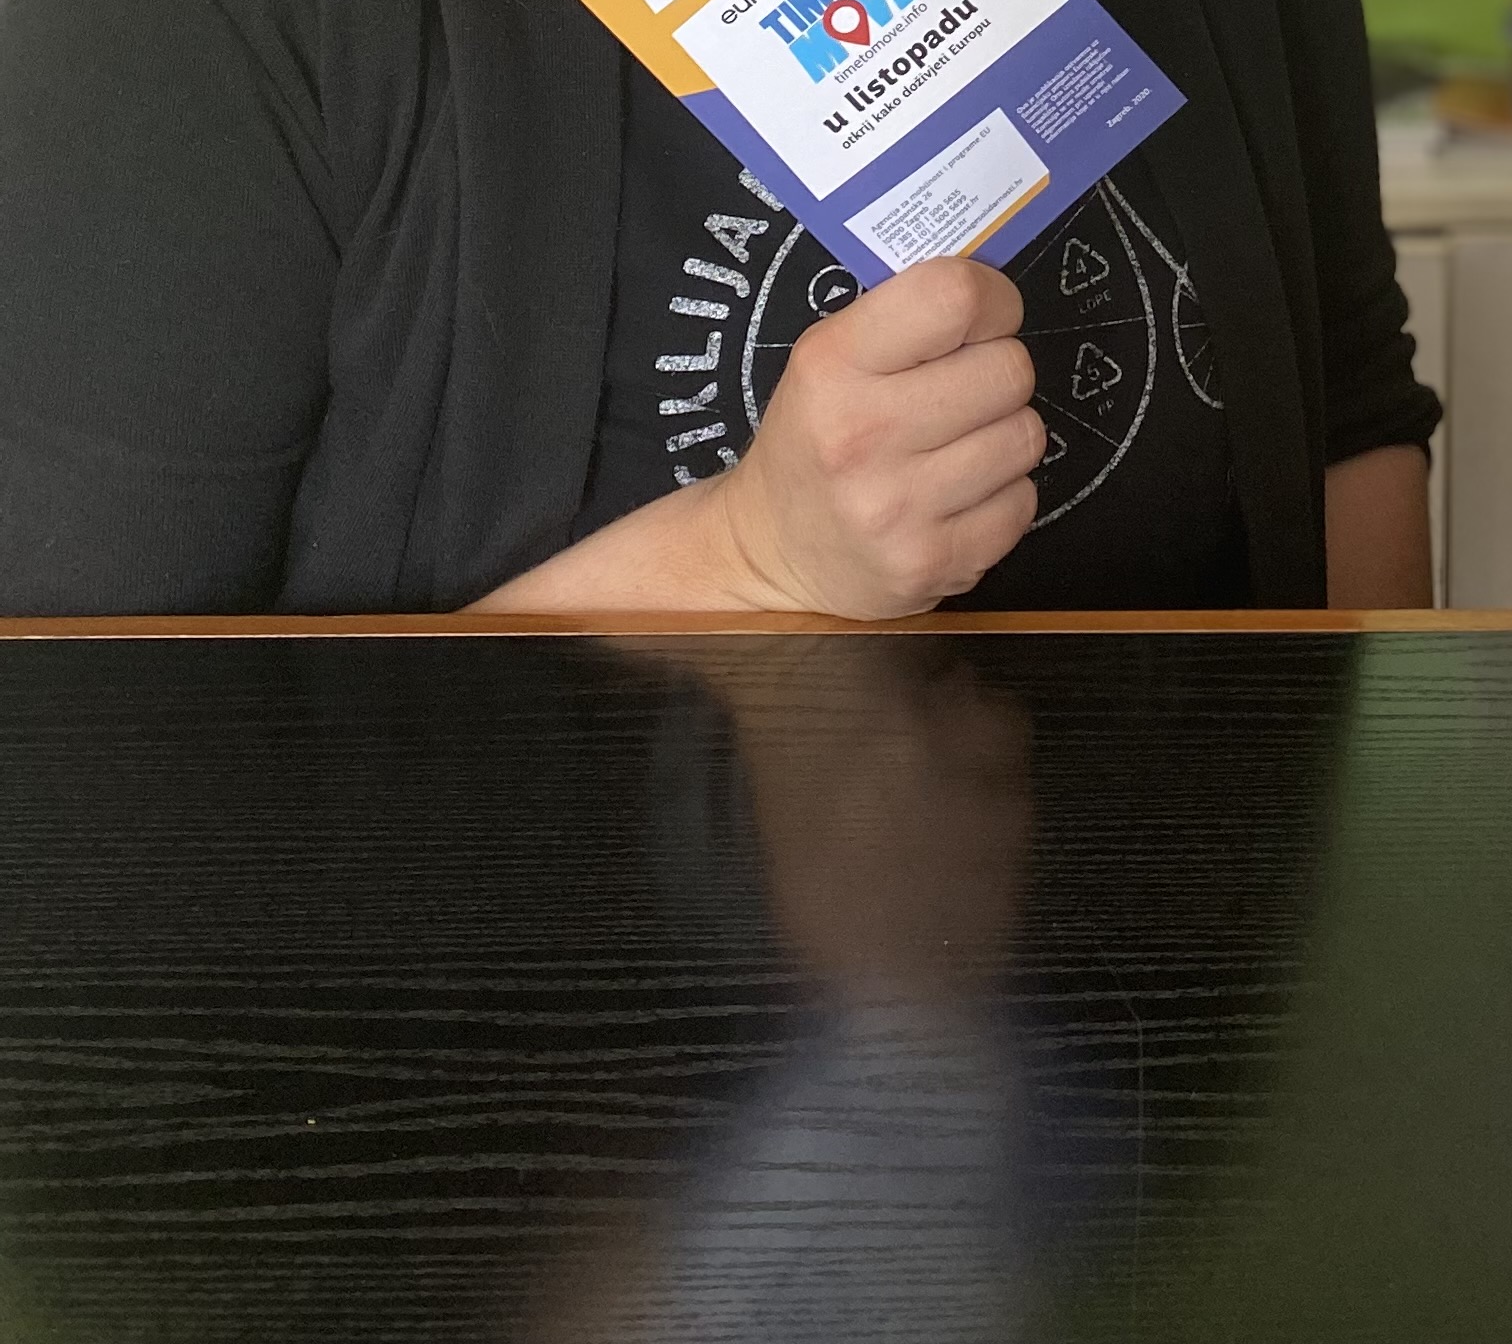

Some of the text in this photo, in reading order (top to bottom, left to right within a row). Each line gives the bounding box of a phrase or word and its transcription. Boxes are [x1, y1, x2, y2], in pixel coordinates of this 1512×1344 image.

[833, 2, 928, 84] timetomove.info
[841, 17, 992, 149] otkrij kako doživjeti Europu
[822, 110, 849, 133] u
[978, 125, 991, 138] EU
